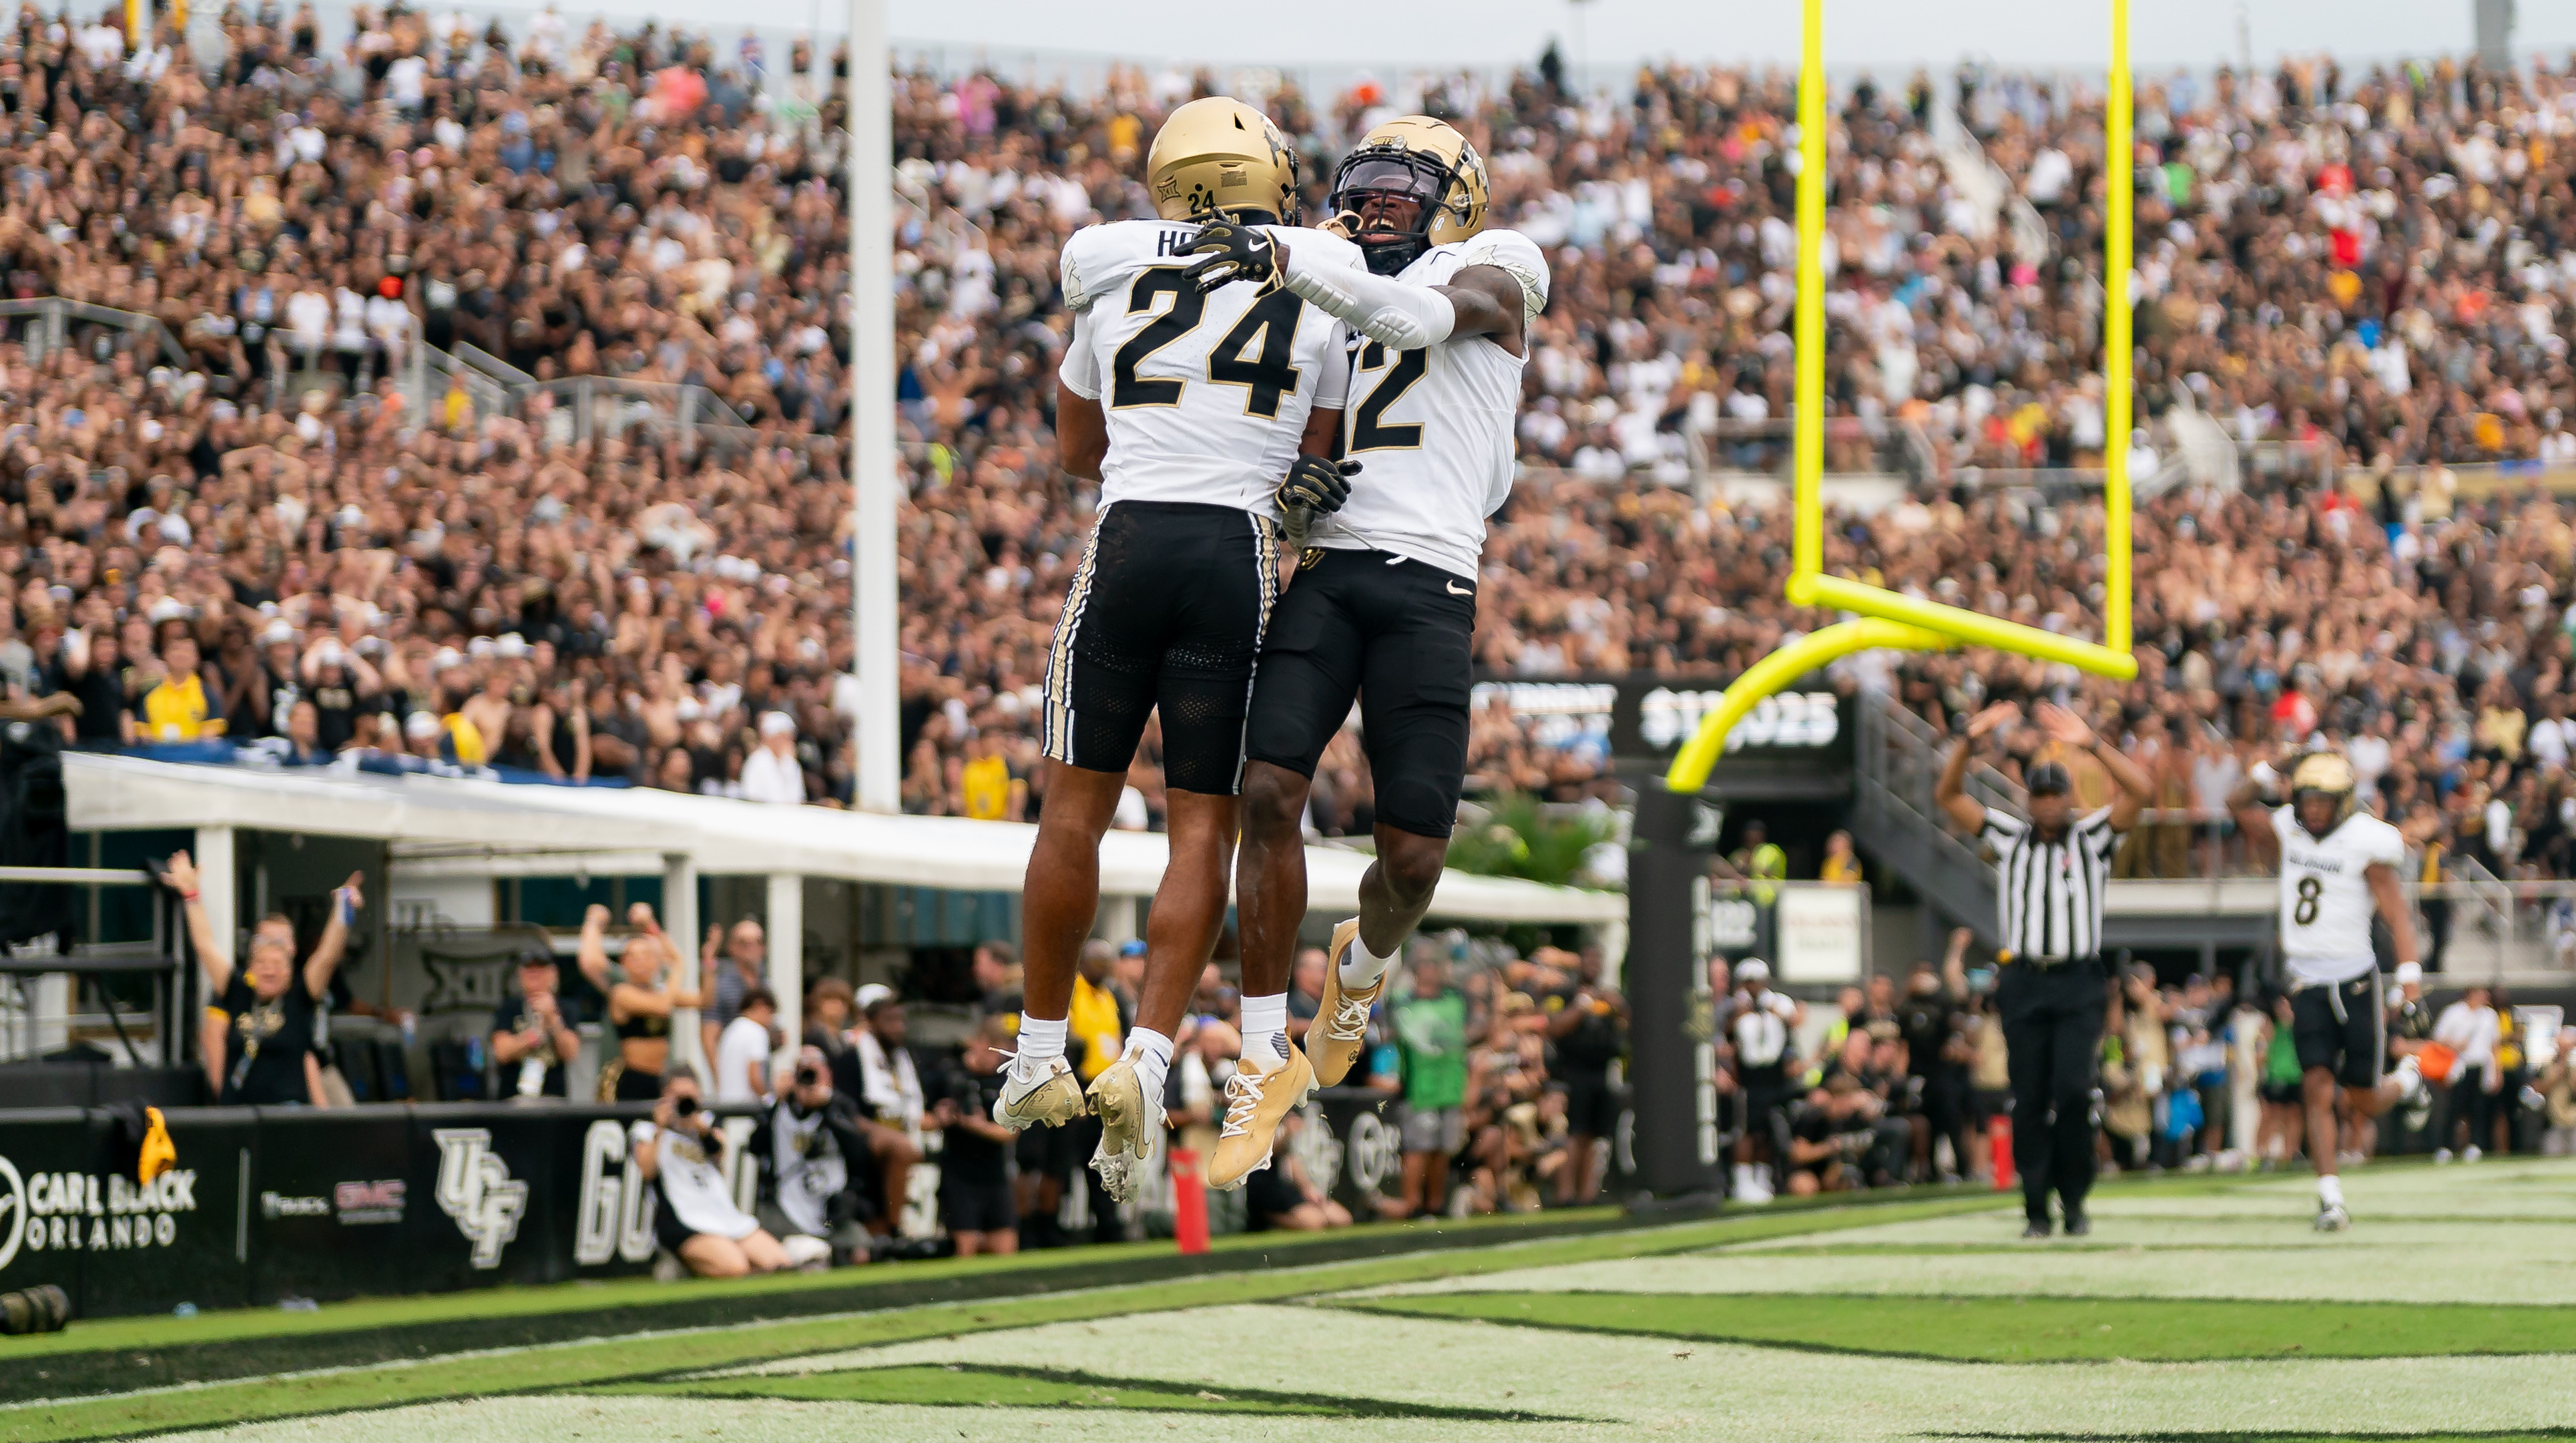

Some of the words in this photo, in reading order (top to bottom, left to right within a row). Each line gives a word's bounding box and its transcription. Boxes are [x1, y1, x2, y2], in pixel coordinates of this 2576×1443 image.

[1188, 190, 1216, 215] 24
[1109, 265, 1306, 421] 24
[1346, 336, 1430, 455] 2
[2295, 875, 2322, 926] 8
[27, 1171, 105, 1217] CARL
[431, 1127, 530, 1269] UCF
[25, 1212, 176, 1251] ORLANDO
